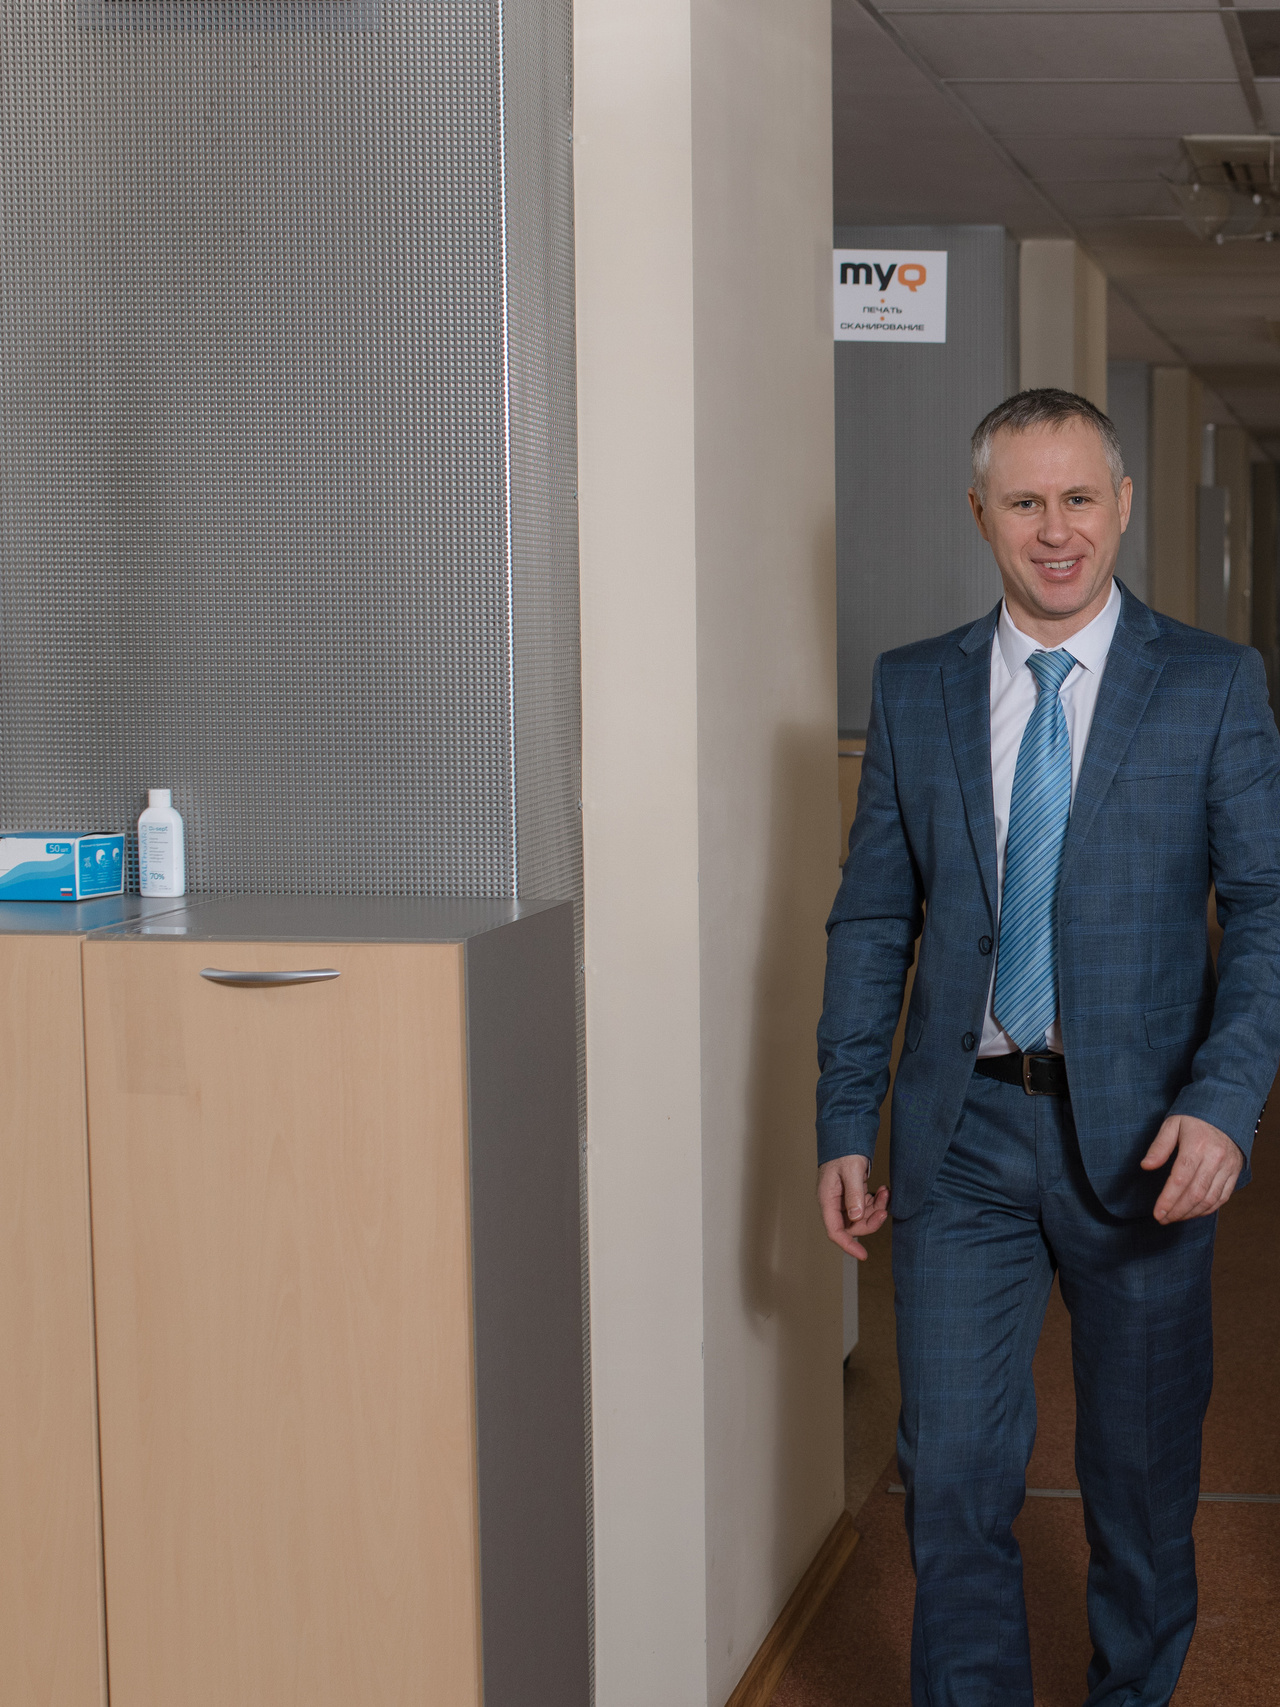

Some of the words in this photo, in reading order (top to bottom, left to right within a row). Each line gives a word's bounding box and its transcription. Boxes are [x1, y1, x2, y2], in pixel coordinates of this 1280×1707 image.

[840, 262, 927, 292] myQ
[862, 306, 903, 314] ПЕЧАТЬ
[840, 322, 925, 332] СКАНИРОВАНИЕ
[49, 844, 60, 853] 50
[149, 872, 165, 880] 70%
